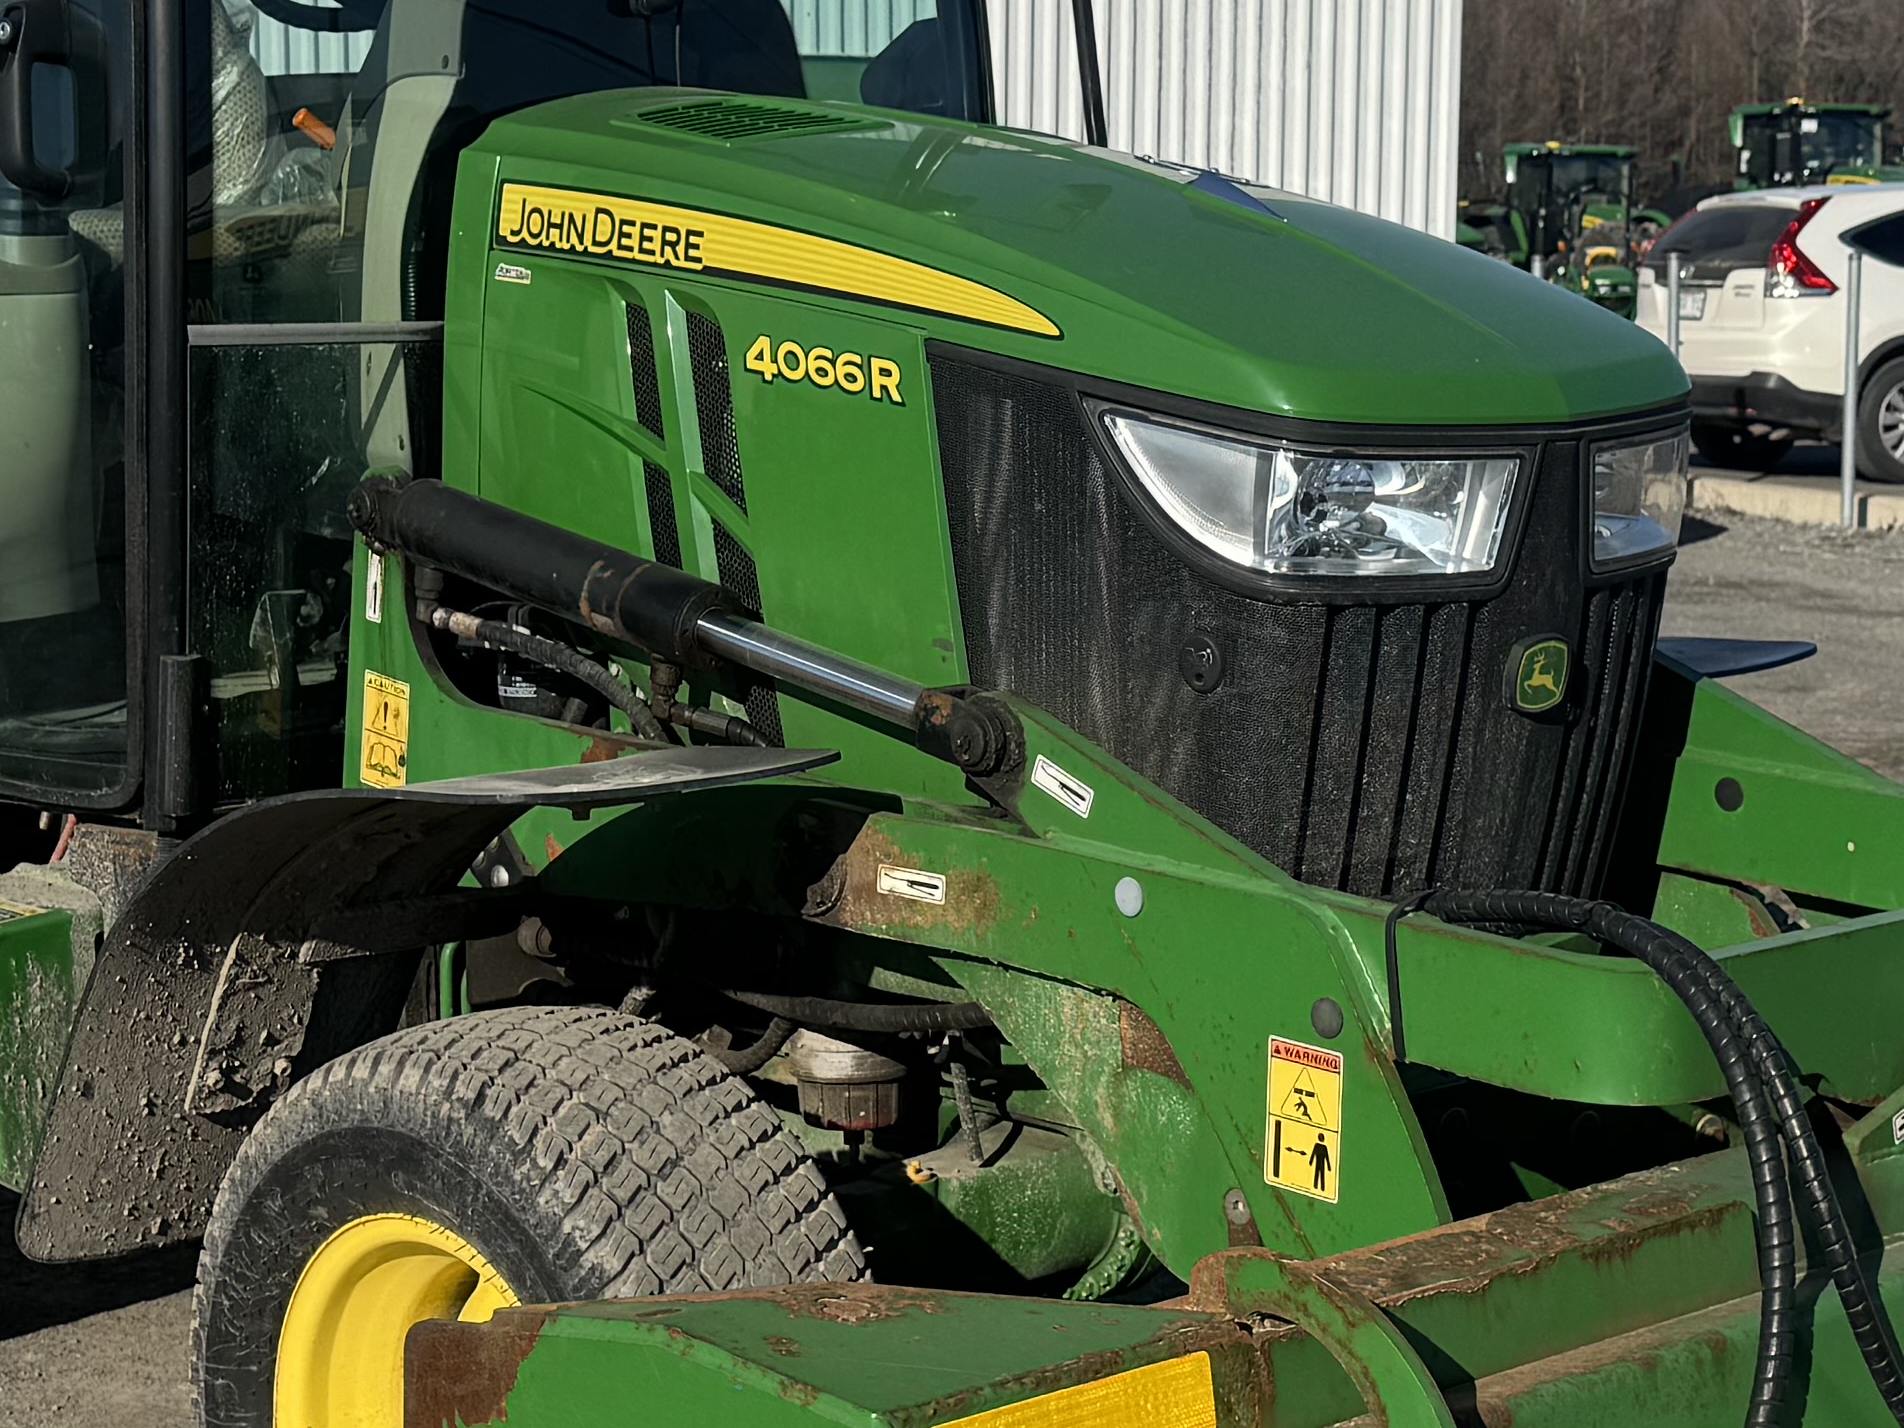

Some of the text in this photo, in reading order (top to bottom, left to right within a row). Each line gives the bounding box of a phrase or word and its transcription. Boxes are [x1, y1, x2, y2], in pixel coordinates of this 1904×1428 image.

[509, 197, 705, 264] JOHN DEERE
[1283, 1046, 1338, 1070] WARNING
